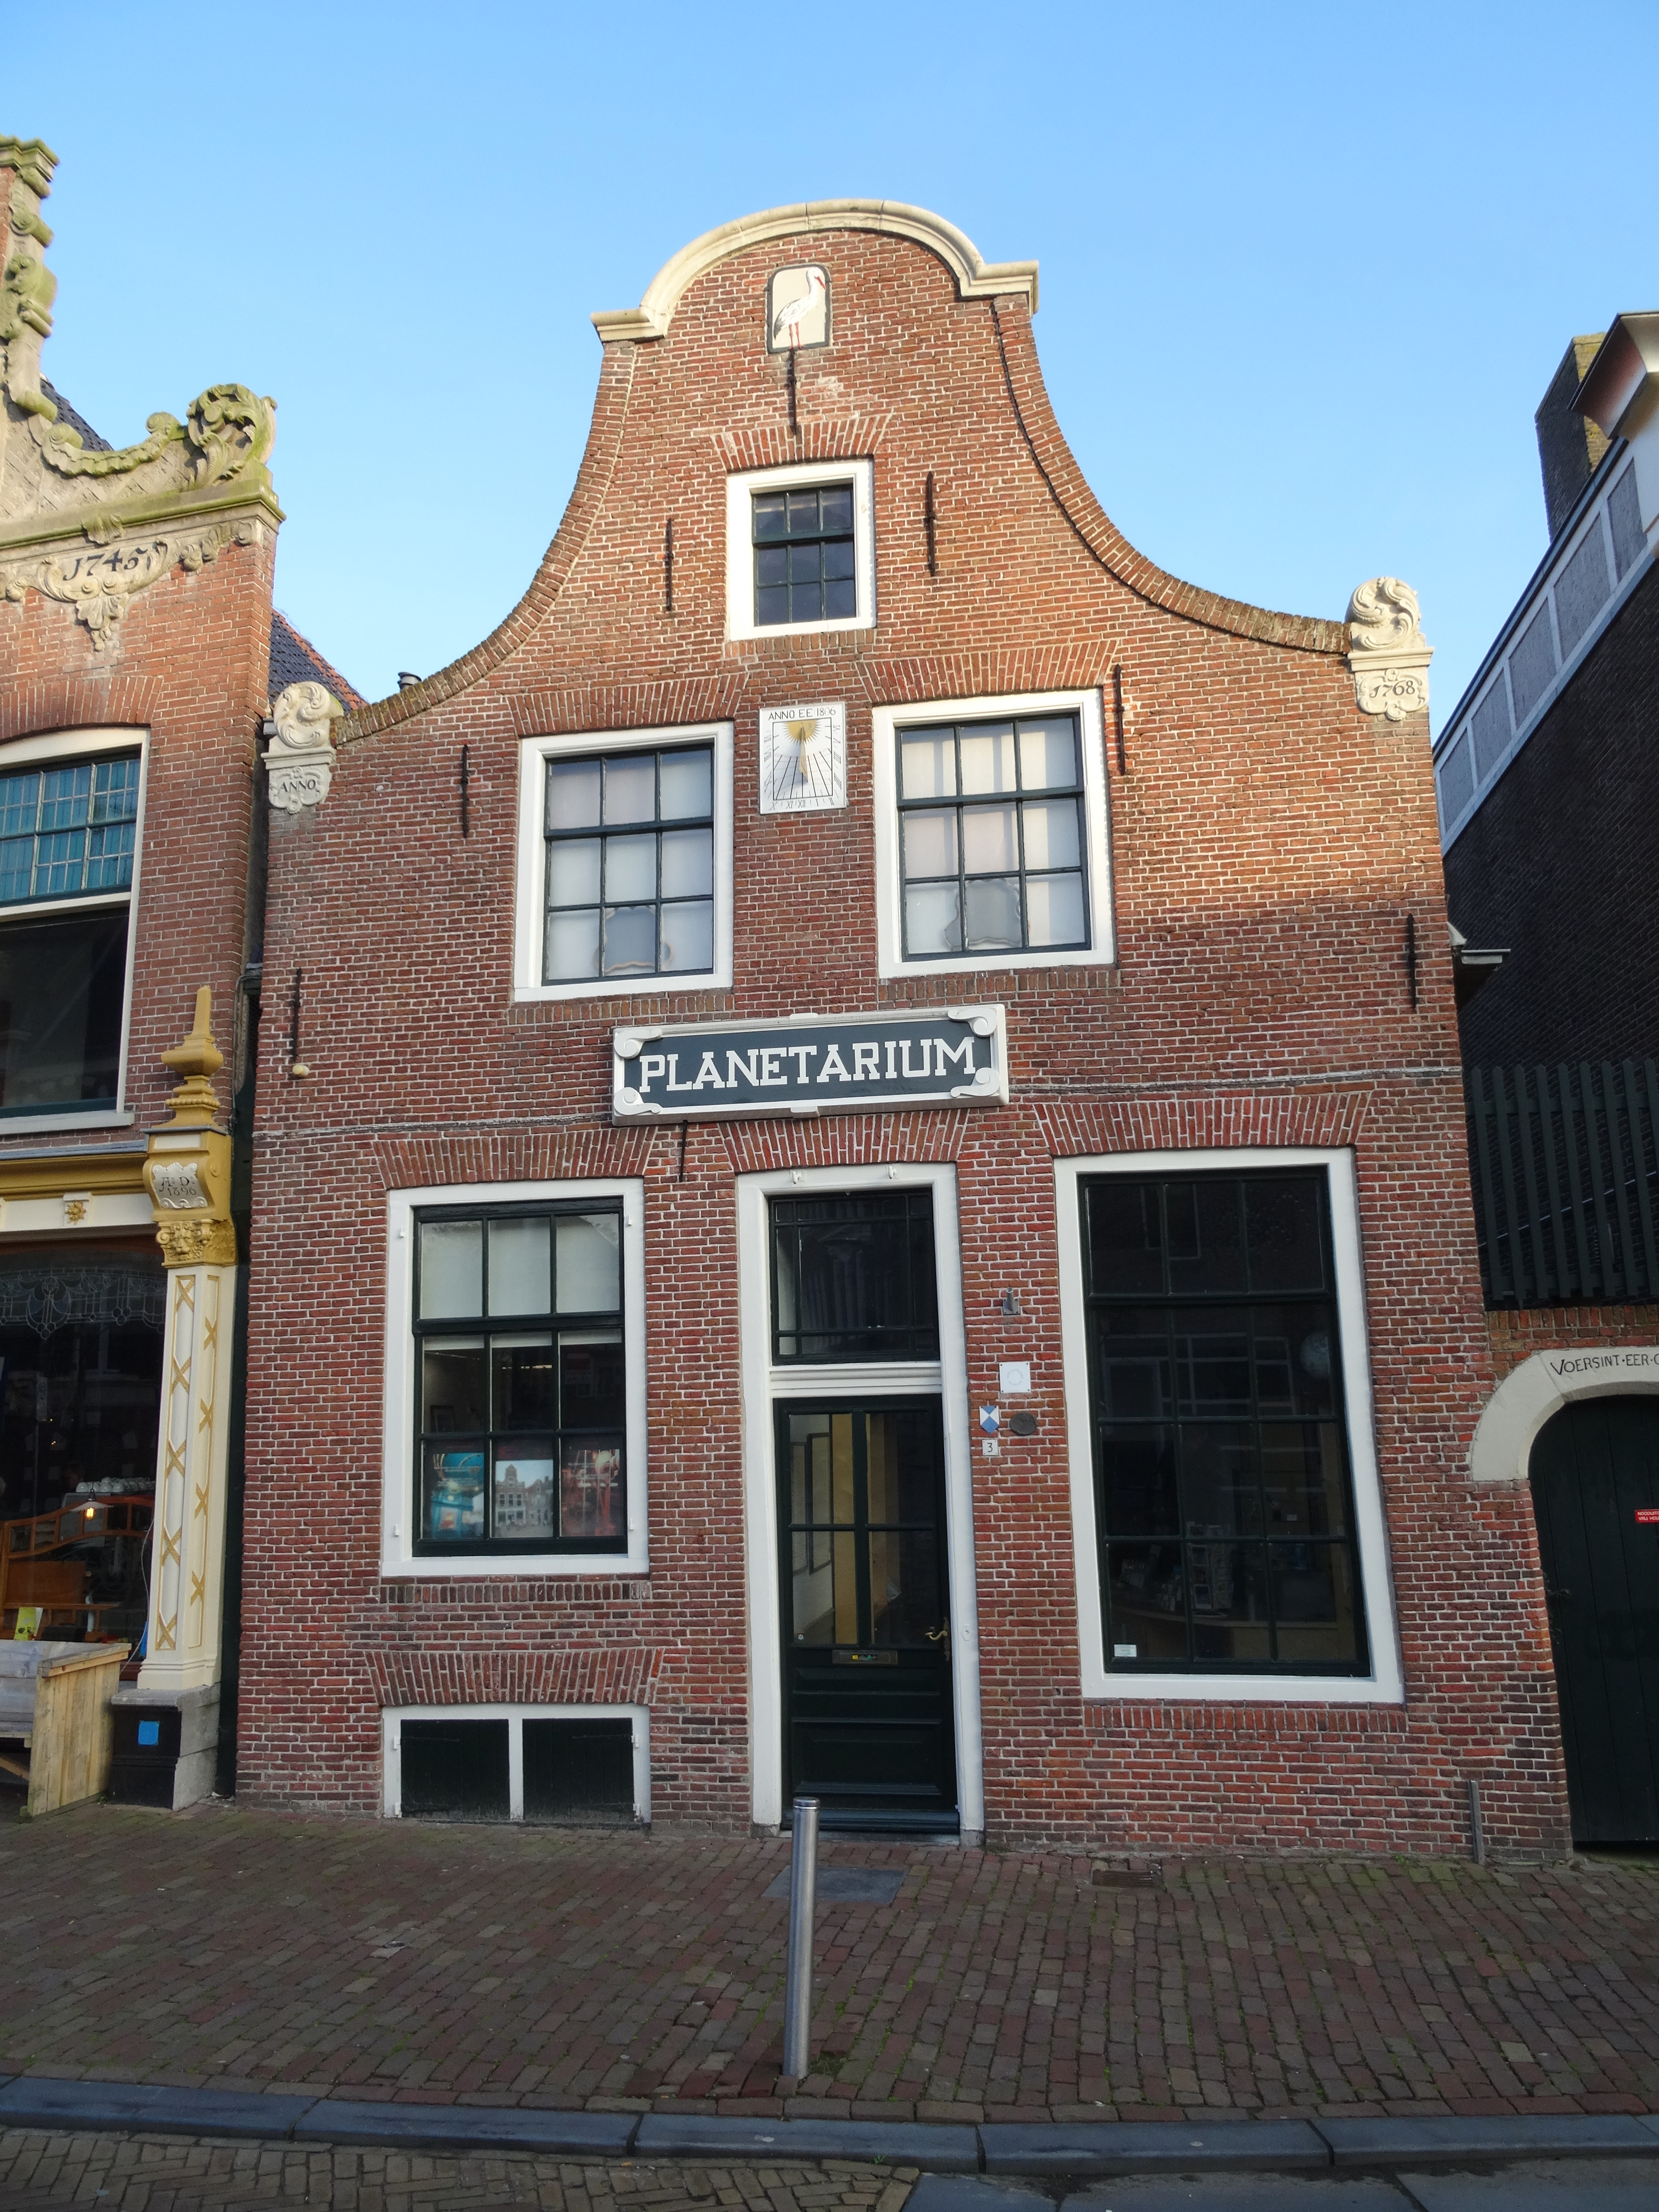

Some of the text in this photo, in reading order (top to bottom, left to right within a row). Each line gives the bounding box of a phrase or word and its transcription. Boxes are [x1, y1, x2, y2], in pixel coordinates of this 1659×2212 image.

[1369, 680, 1416, 699] 1768
[768, 707, 836, 721] ANNO EE 1806
[279, 779, 316, 793] ANNO
[797, 800, 806, 808] XII
[638, 1036, 976, 1093] PLANETARIUM
[168, 1186, 197, 1196] 1896
[987, 1442, 993, 1453] 3
